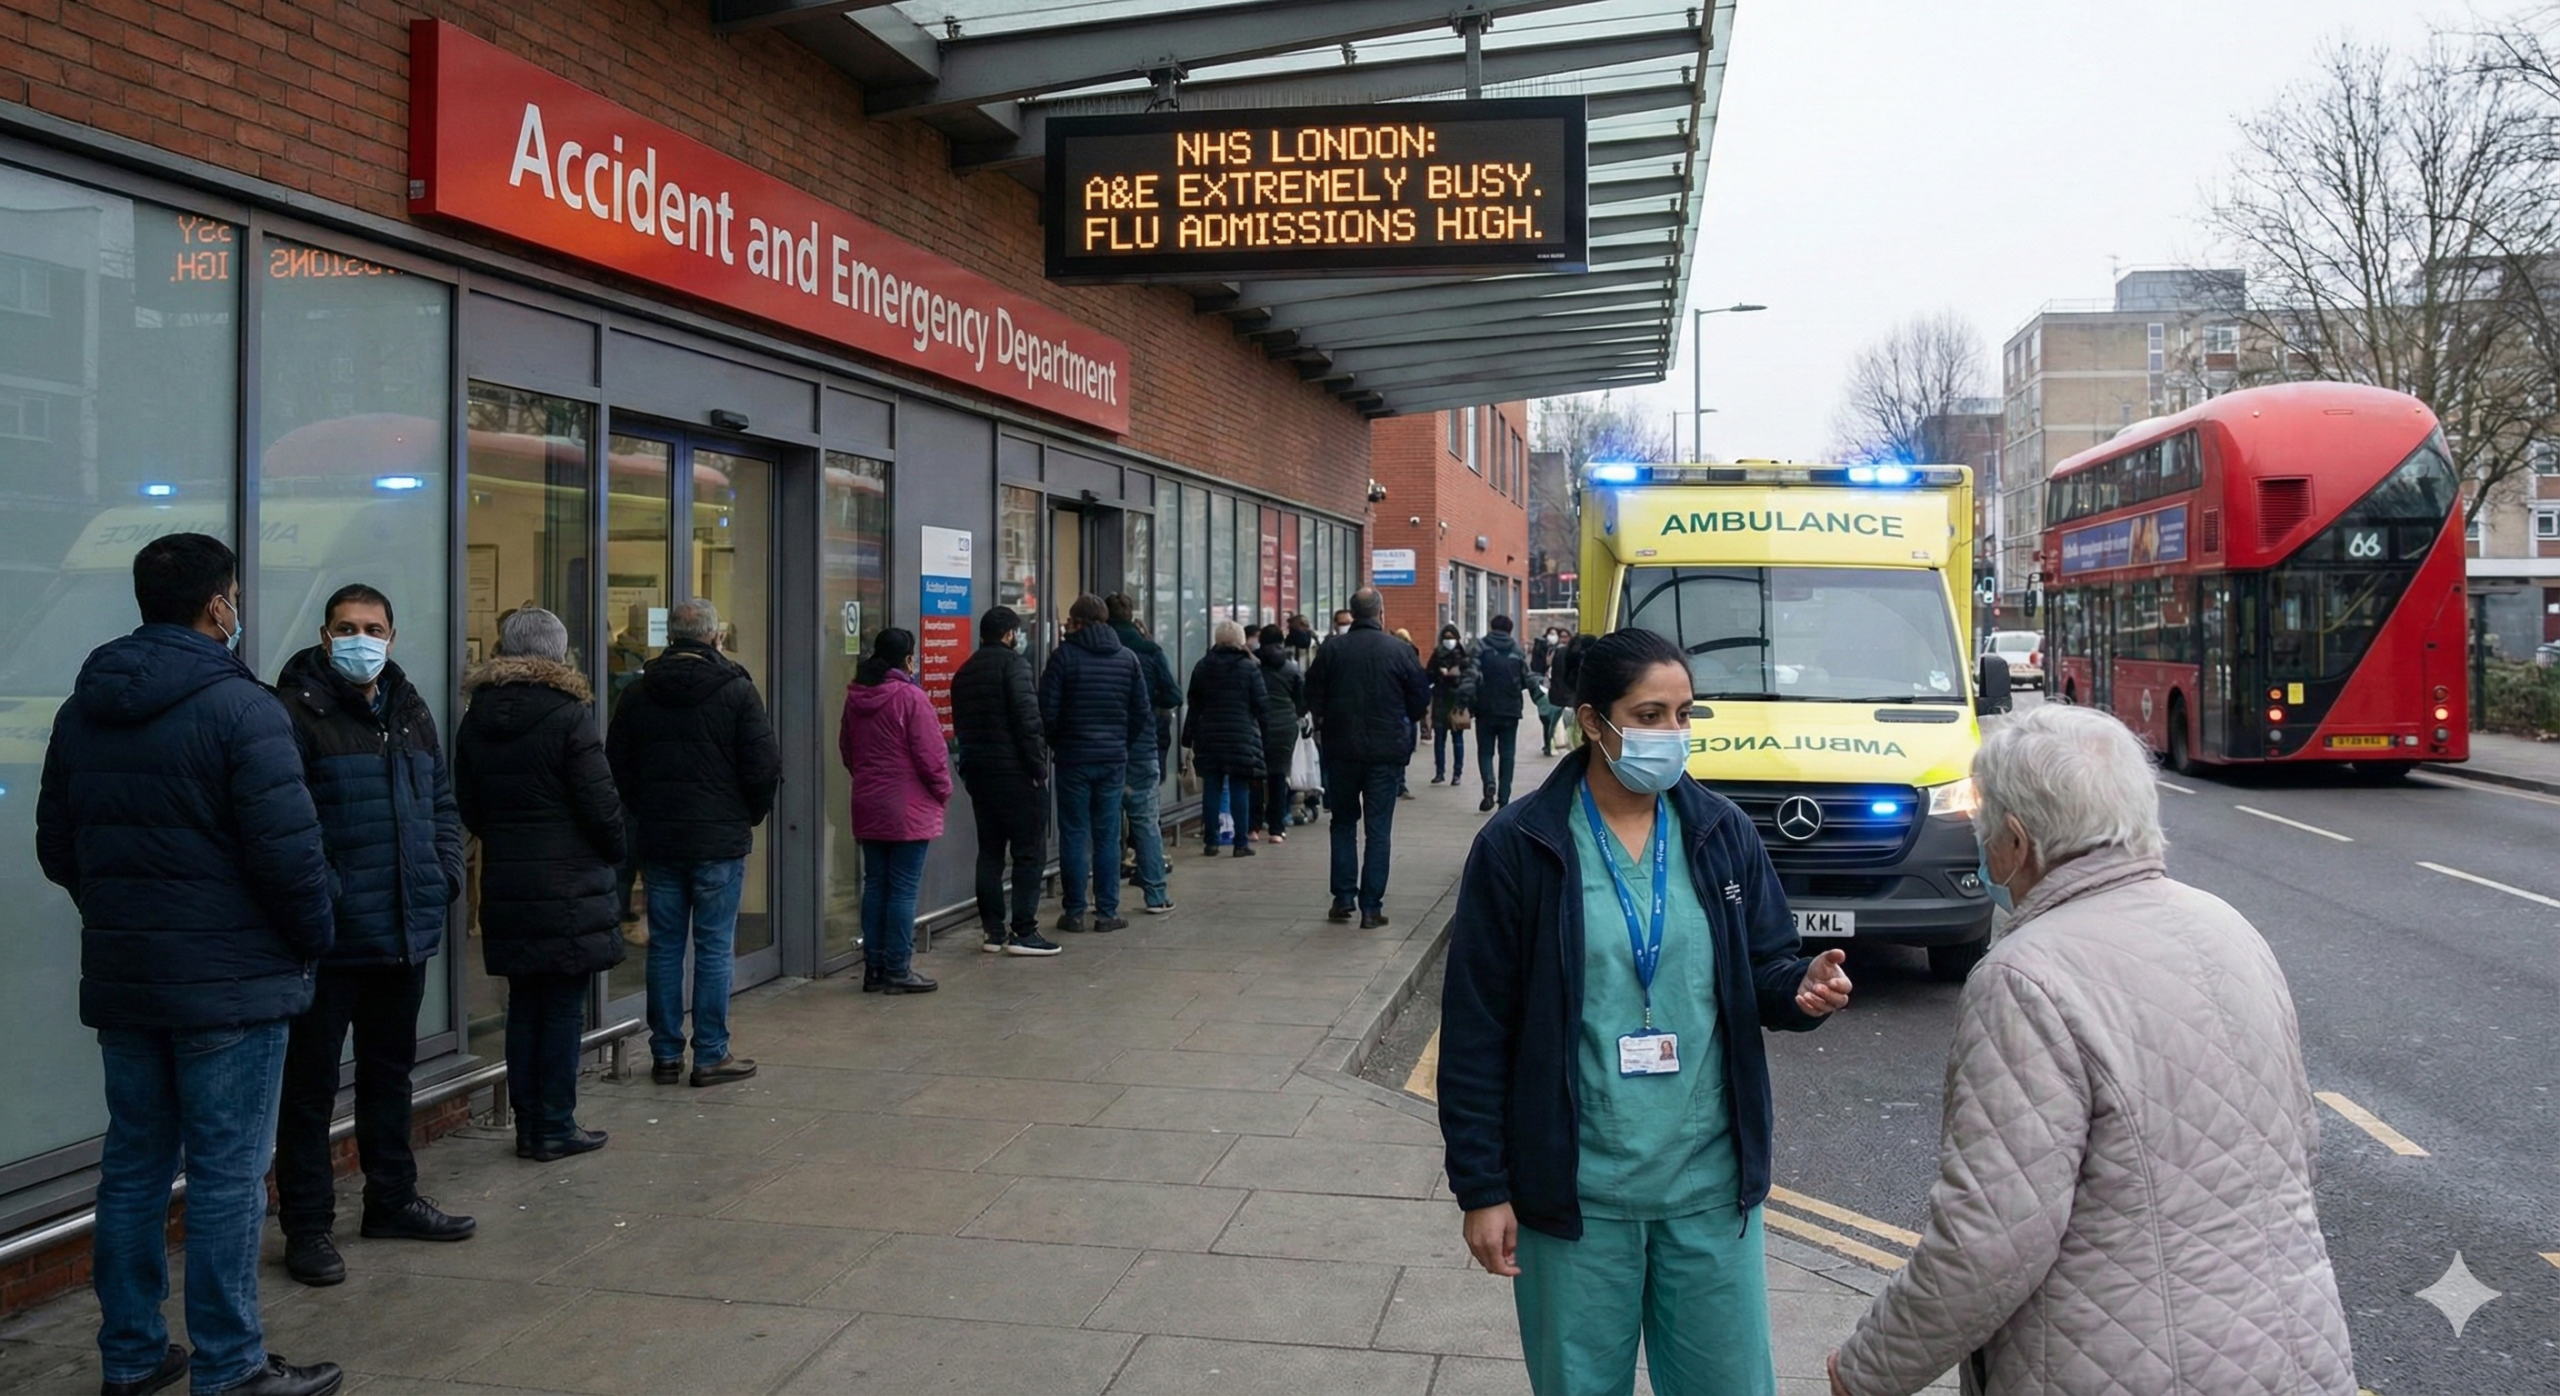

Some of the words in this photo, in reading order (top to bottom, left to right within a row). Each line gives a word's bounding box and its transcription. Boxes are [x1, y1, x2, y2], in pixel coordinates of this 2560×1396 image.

[1178, 132, 1251, 166] NHS
[1271, 126, 1436, 164] LONDON:
[1086, 175, 1158, 210] A&E
[1178, 166, 1407, 207] EXTREMELY
[1429, 163, 1541, 199] BUSY.
[1087, 216, 1158, 250] FLU
[1180, 209, 1415, 248] ADMISSIONS
[1438, 206, 1542, 240] HIGH.
[510, 103, 733, 264] Accident
[748, 218, 817, 295] and
[833, 235, 988, 372] Emergency
[998, 308, 1116, 405] Department
[1661, 511, 1904, 538] AMBULANCE
[2349, 532, 2381, 557] 66
[1806, 913, 1843, 931] KML
